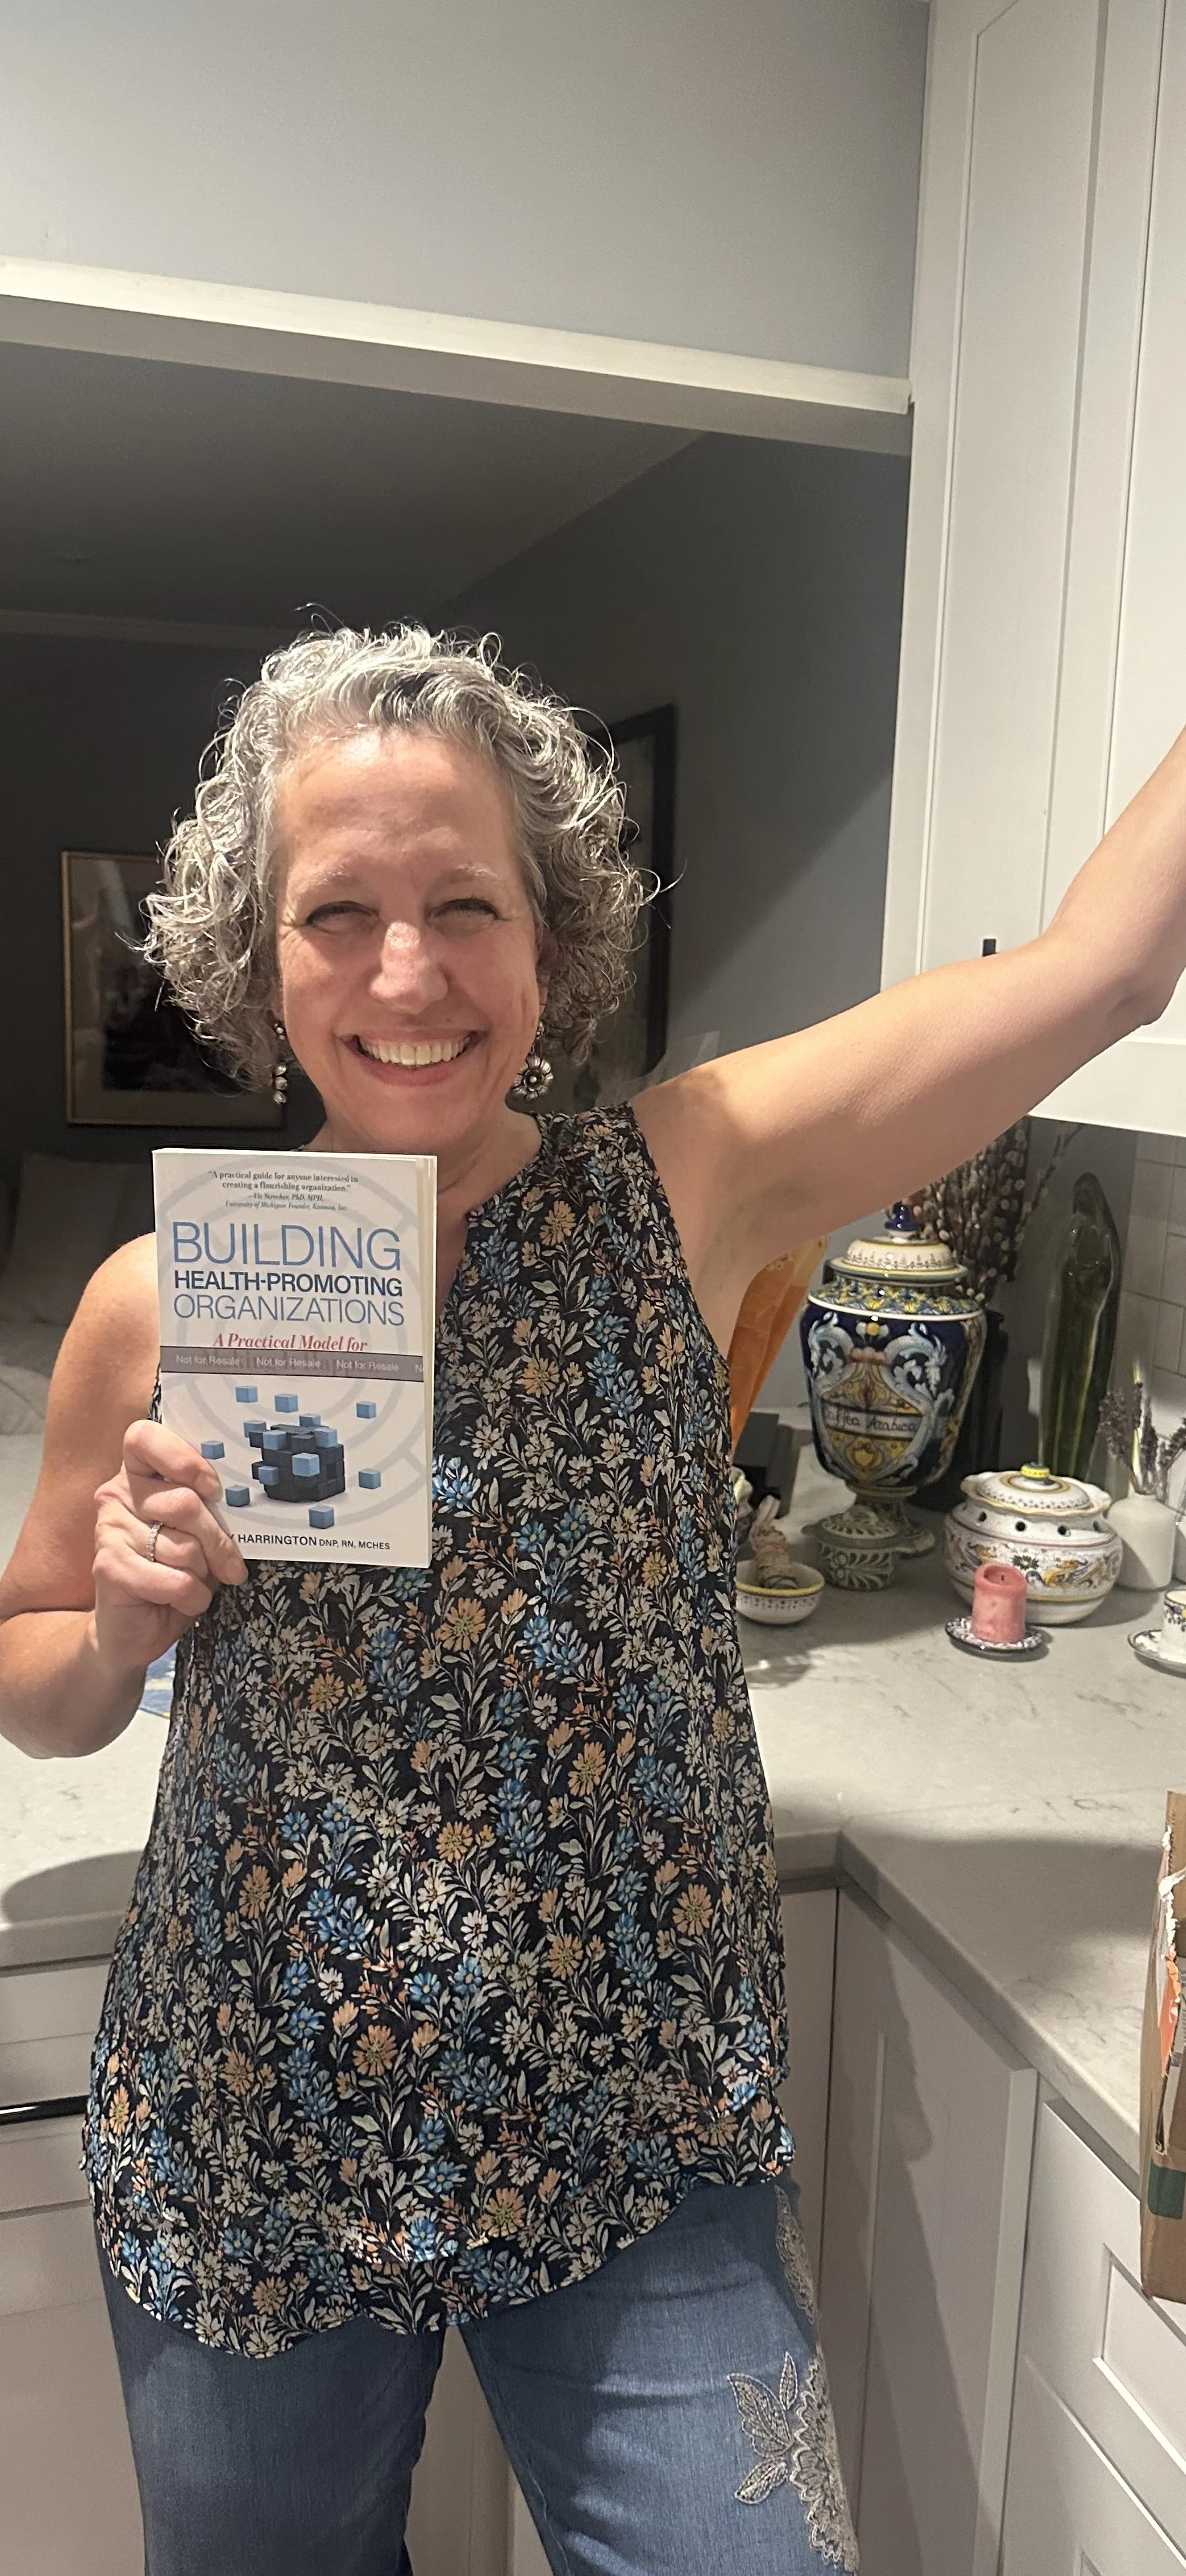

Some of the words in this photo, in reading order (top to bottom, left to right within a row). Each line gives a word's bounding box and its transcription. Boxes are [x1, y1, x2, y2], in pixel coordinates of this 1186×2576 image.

[219, 1170, 251, 1180] practical
[253, 1172, 272, 1180] guide
[313, 1174, 349, 1183] interested
[222, 1182, 252, 1190] creating
[260, 1181, 299, 1192] flourishing
[173, 1222, 401, 1271] BUILDING
[175, 1270, 403, 1297] HEALTH-PROMOTING
[173, 1294, 405, 1327] ORGANIZATIONS
[213, 1333, 223, 1347] A
[228, 1333, 296, 1349] Practical
[299, 1335, 345, 1351] Model
[346, 1337, 368, 1352] for
[176, 1355, 192, 1365] Not
[194, 1356, 207, 1365] for
[208, 1356, 240, 1366] Resale
[256, 1357, 273, 1367] Not
[273, 1358, 286, 1367] for
[289, 1358, 320, 1368] Resale
[336, 1359, 353, 1369] Not
[354, 1361, 366, 1370] for
[368, 1361, 399, 1371] Resale
[238, 1533, 318, 1547] HARRINGTON
[319, 1539, 339, 1548] DNP,
[341, 1539, 356, 1548] RN,
[358, 1541, 390, 1550] MCHES
